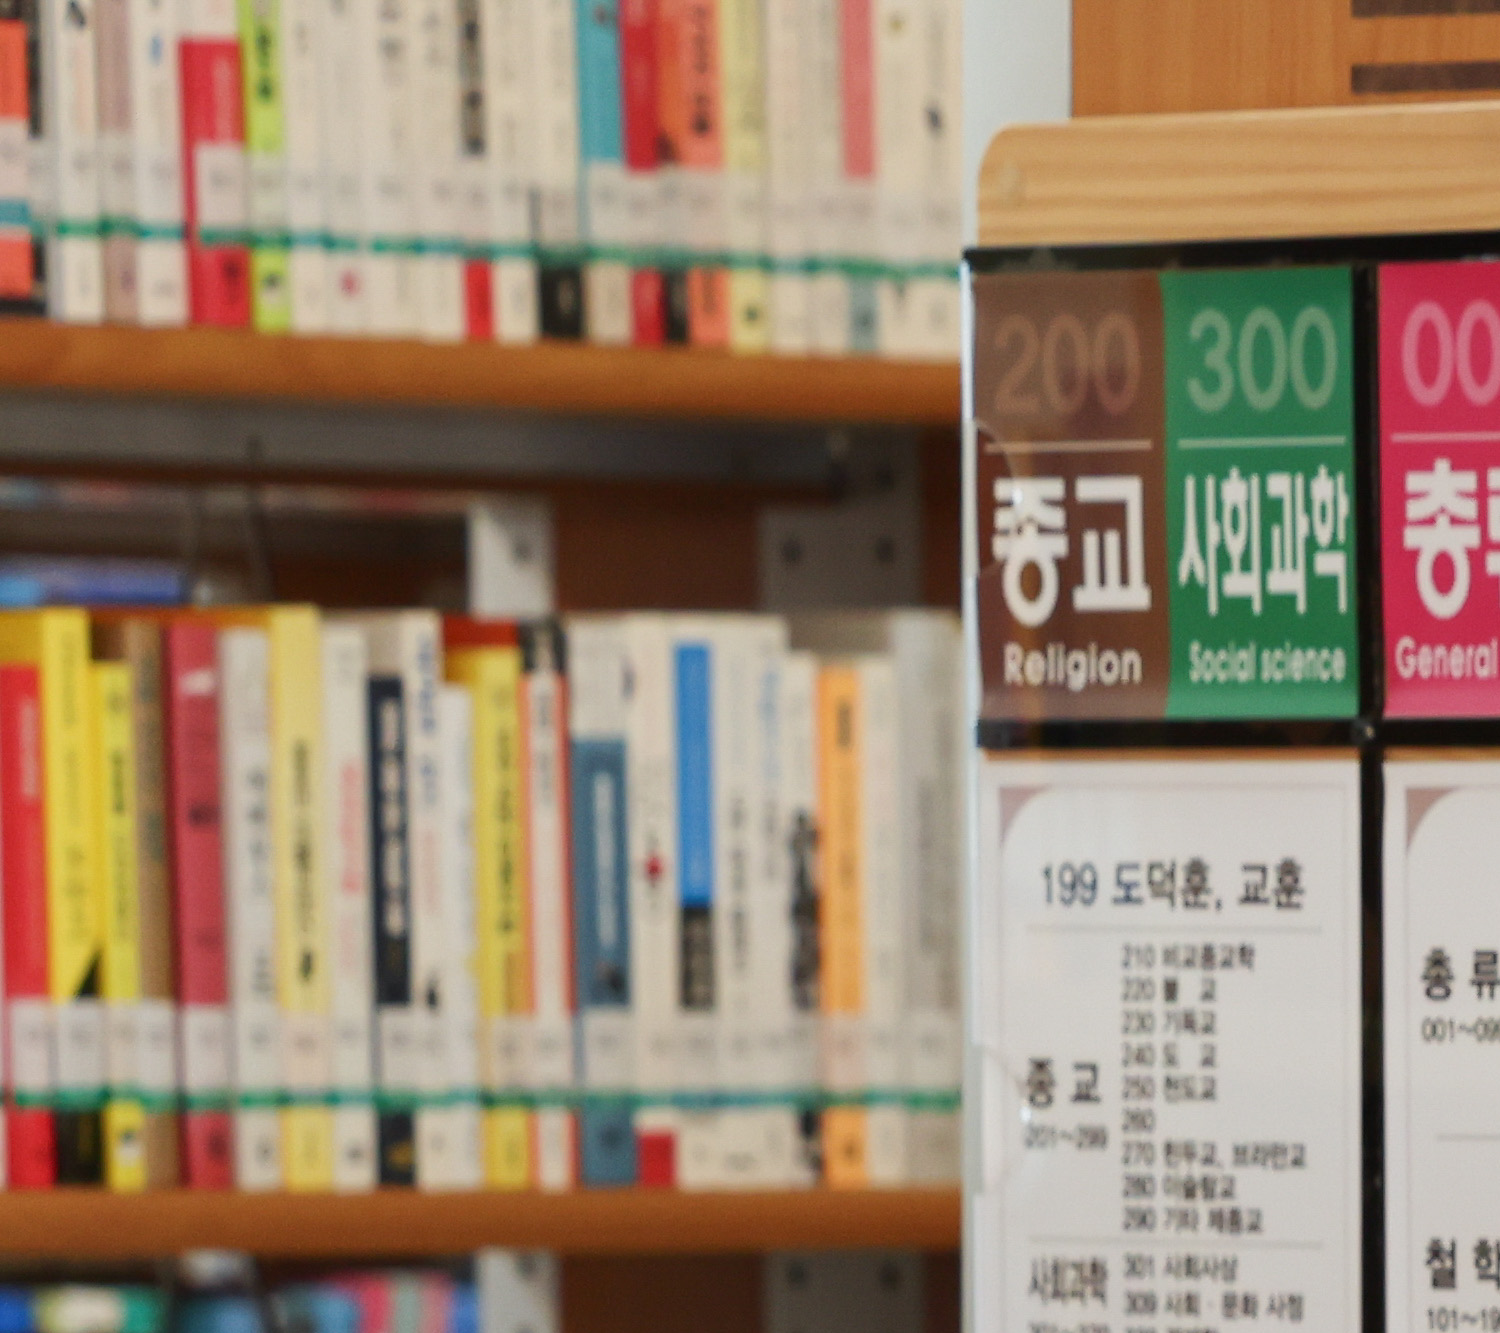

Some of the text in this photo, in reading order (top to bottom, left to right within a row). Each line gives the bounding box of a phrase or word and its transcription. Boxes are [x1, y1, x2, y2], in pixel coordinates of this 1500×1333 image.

[998, 311, 1141, 418] 200
[1188, 306, 1338, 413] 300
[992, 475, 1153, 628] 종교
[1179, 466, 1349, 615] 사회과학
[1005, 642, 1141, 693] Religion
[1189, 641, 1347, 684] Social science
[1397, 636, 1497, 679] General
[1043, 862, 1098, 907] 199
[1239, 858, 1304, 910] 교훈
[1421, 948, 1500, 1001] 총 류
[1025, 1059, 1101, 1108] 종 교
[1426, 1239, 1456, 1290] 철
